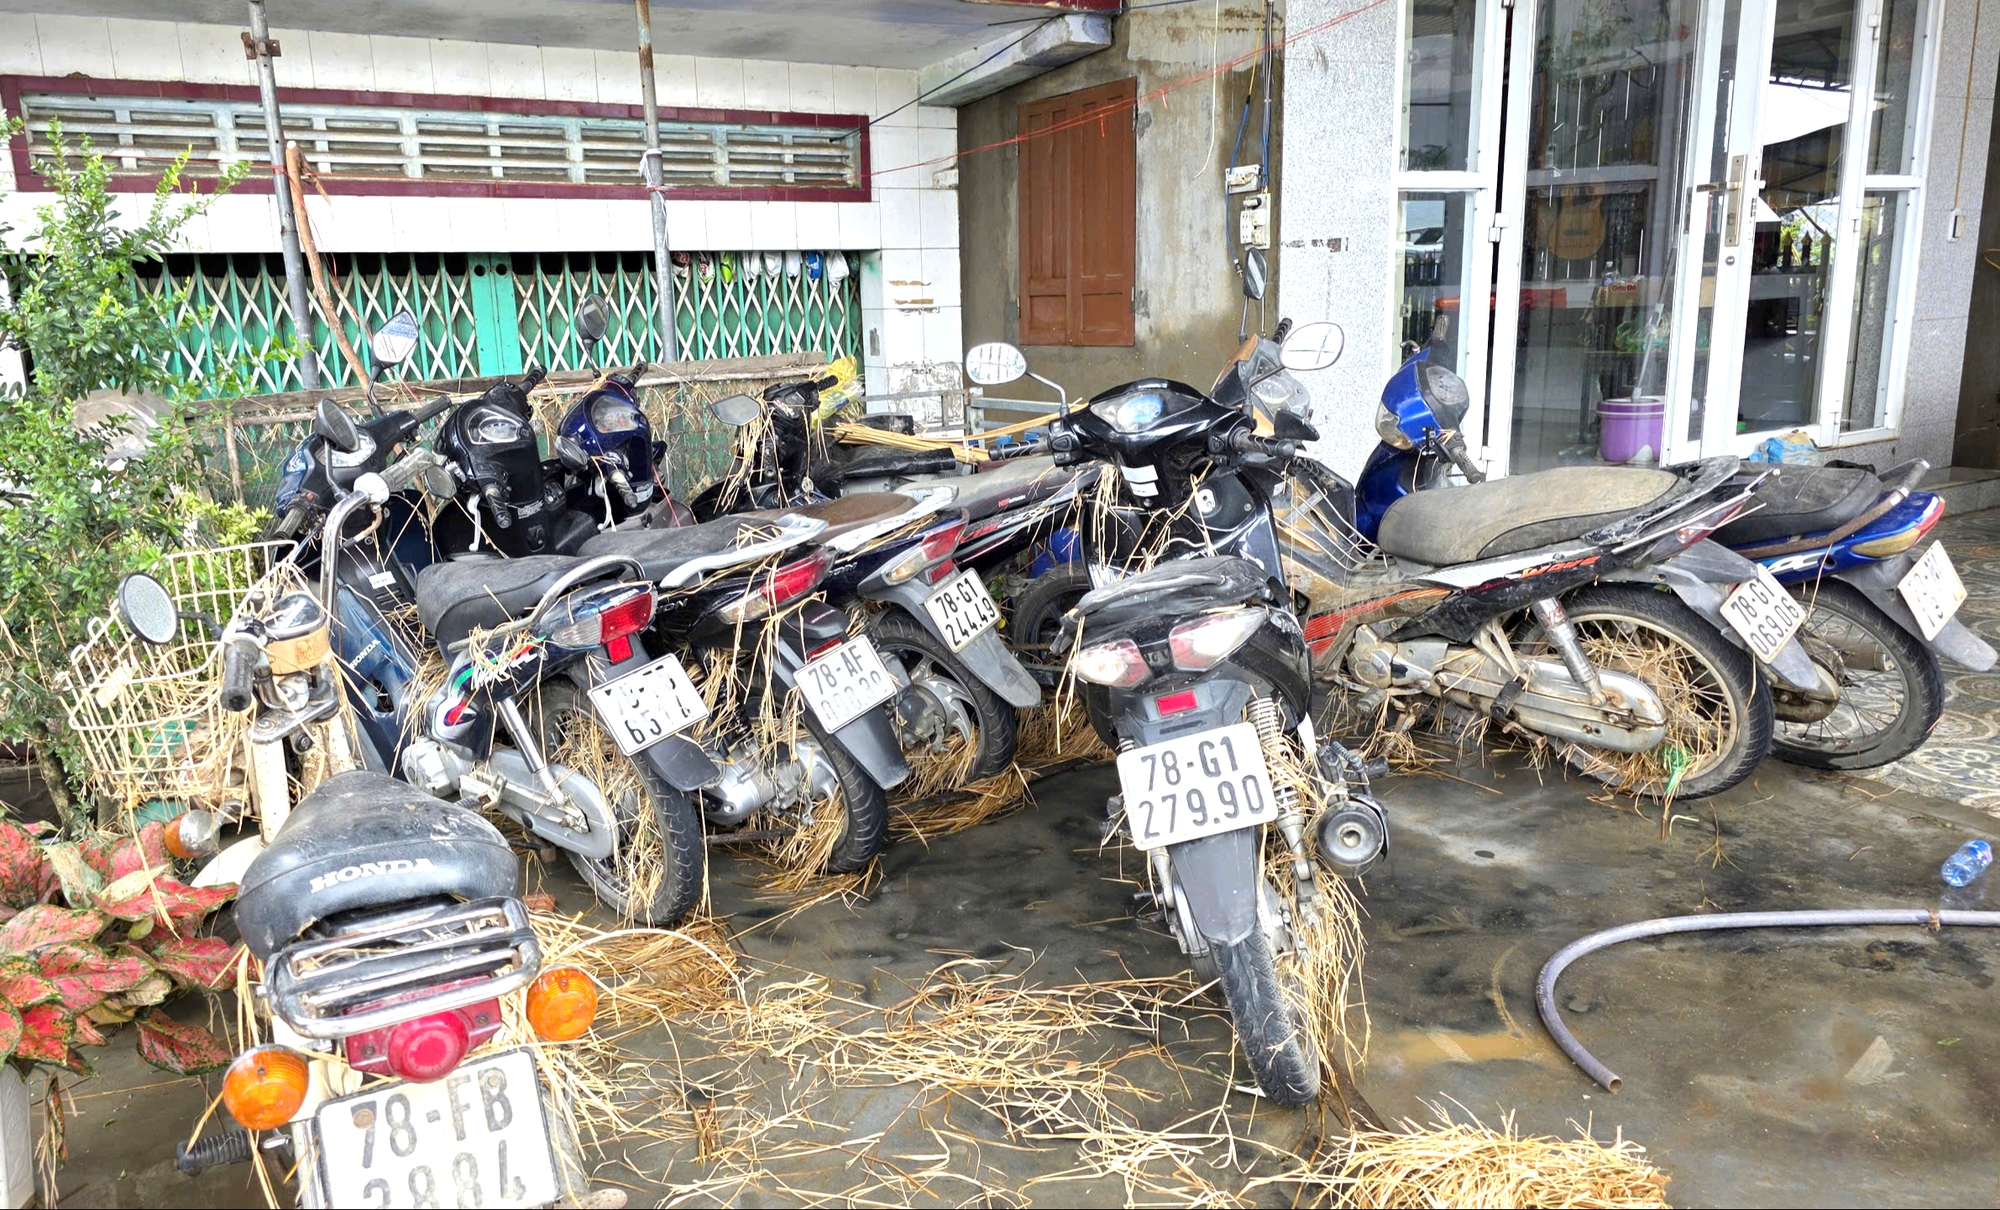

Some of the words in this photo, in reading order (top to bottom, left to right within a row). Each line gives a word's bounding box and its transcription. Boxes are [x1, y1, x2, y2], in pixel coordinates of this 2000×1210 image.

[934, 577, 979, 620] 78-G1
[945, 597, 996, 647] 244.49
[1730, 577, 1775, 626] 78-G1
[1749, 596, 1800, 656] 069.06
[350, 639, 381, 670] HONDA
[807, 644, 864, 696] 78-AF
[1140, 736, 1239, 792] 78-G1
[1138, 774, 1265, 840] 279.90
[309, 858, 439, 894] HONDA
[350, 1067, 513, 1169] 78-FB
